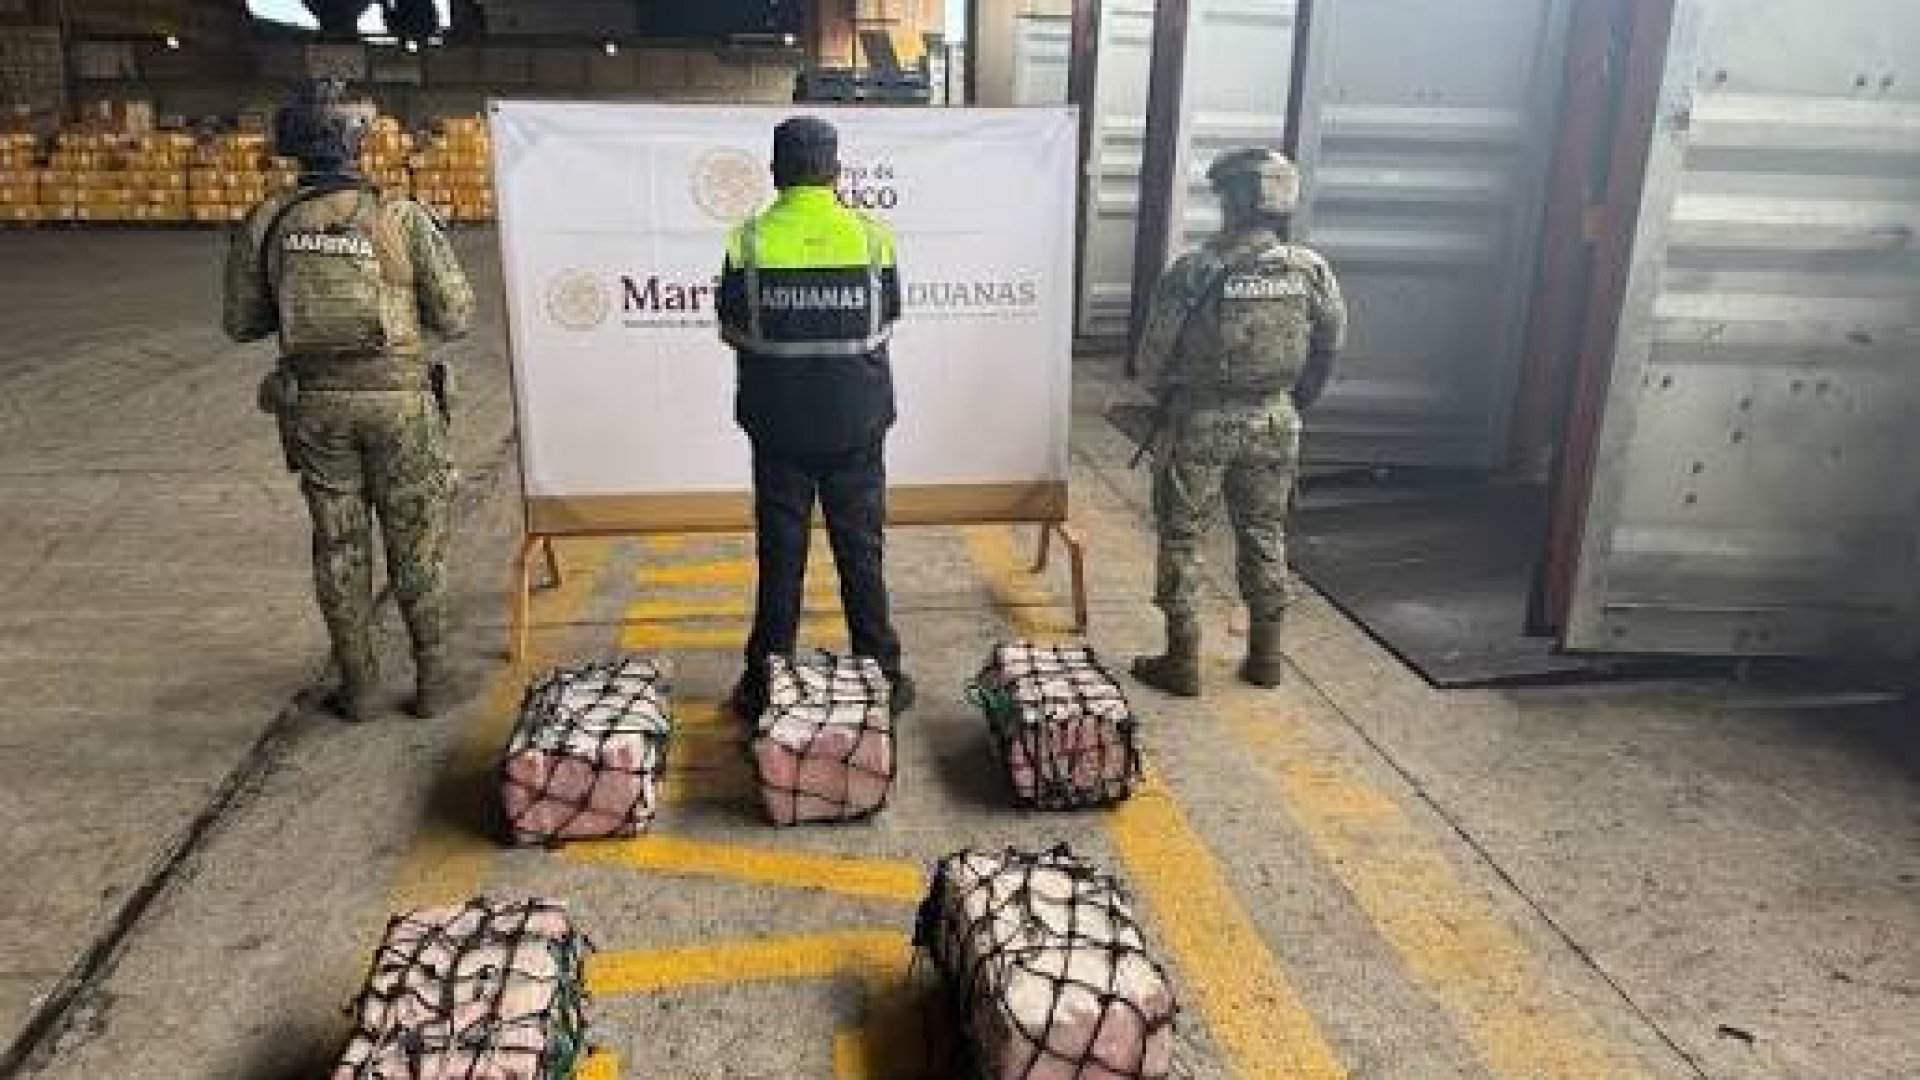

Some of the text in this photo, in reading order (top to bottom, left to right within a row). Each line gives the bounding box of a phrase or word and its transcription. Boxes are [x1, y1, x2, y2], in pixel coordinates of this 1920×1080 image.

[283, 234, 373, 256] MARINA
[761, 286, 864, 309] ADUANAS
[907, 282, 1037, 305] DUANAS
